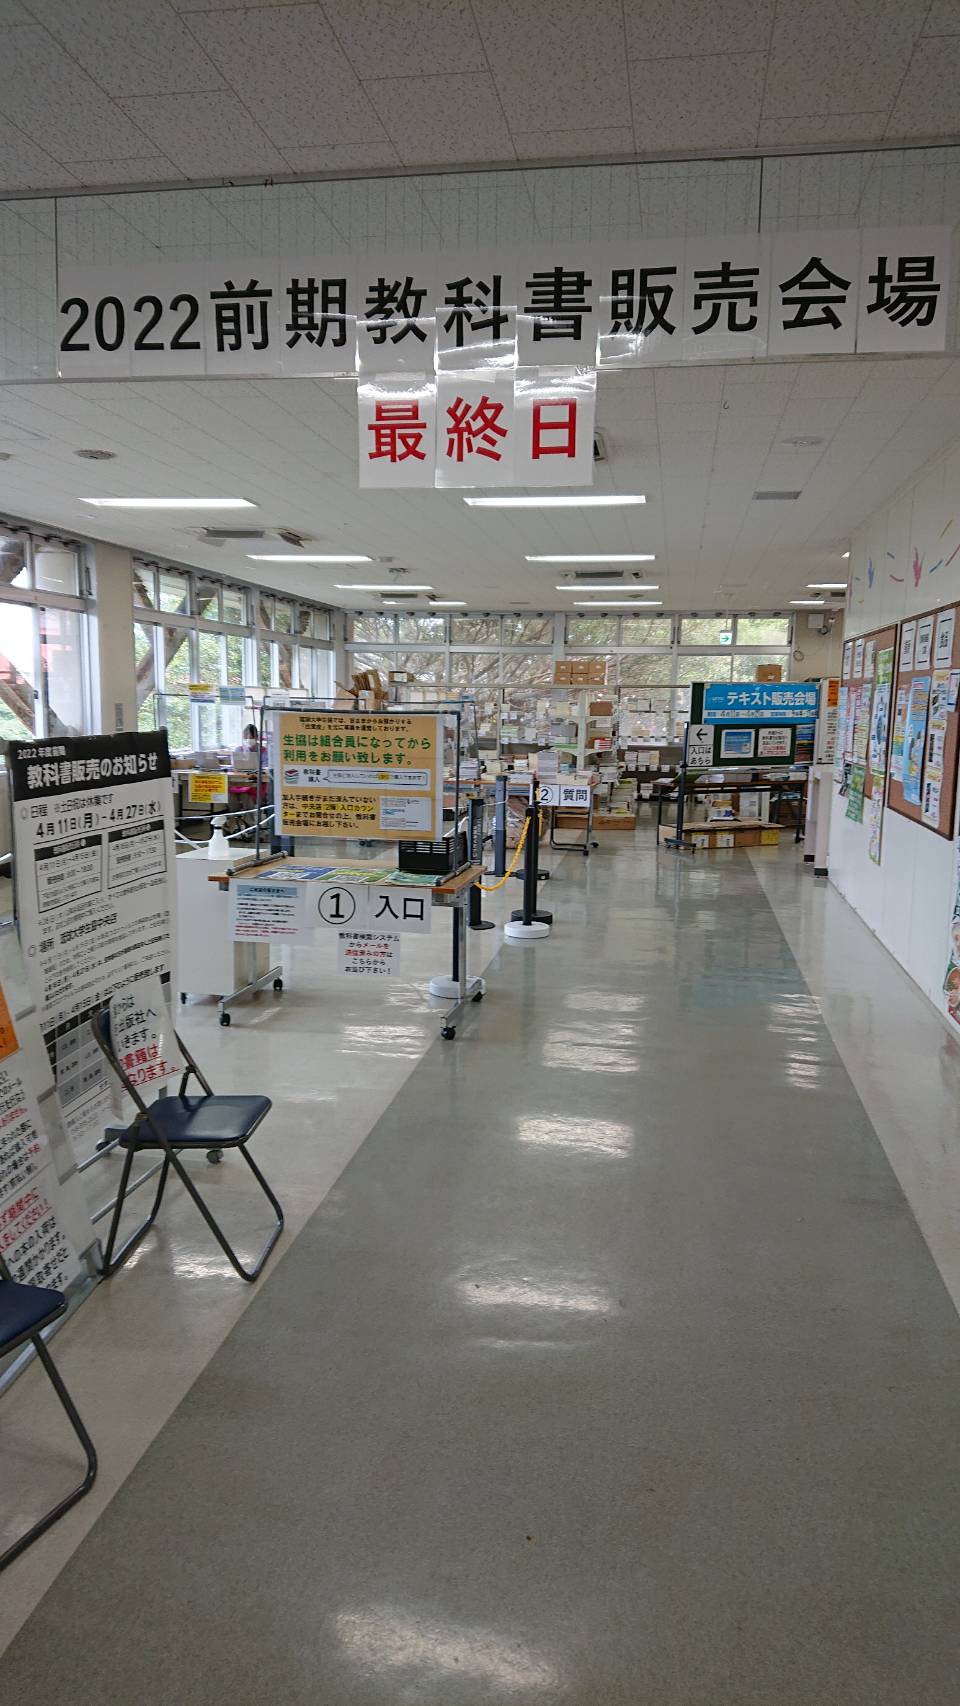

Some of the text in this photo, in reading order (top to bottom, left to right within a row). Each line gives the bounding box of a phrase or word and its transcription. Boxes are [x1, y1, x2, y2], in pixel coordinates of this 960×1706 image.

[59, 254, 942, 353] 2022前期教科書販売会場
[366, 396, 580, 463] 最終日
[727, 691, 817, 706] テキスト販売会場
[283, 734, 431, 750] 生協は組合員になってから
[283, 749, 412, 766] 利用をお願い致します。
[691, 746, 711, 756] 入口は
[690, 756, 711, 766] あちら
[27, 752, 158, 790] 教科書販売のお知らせ
[563, 788, 588, 802] 質問
[375, 895, 424, 921] 入口
